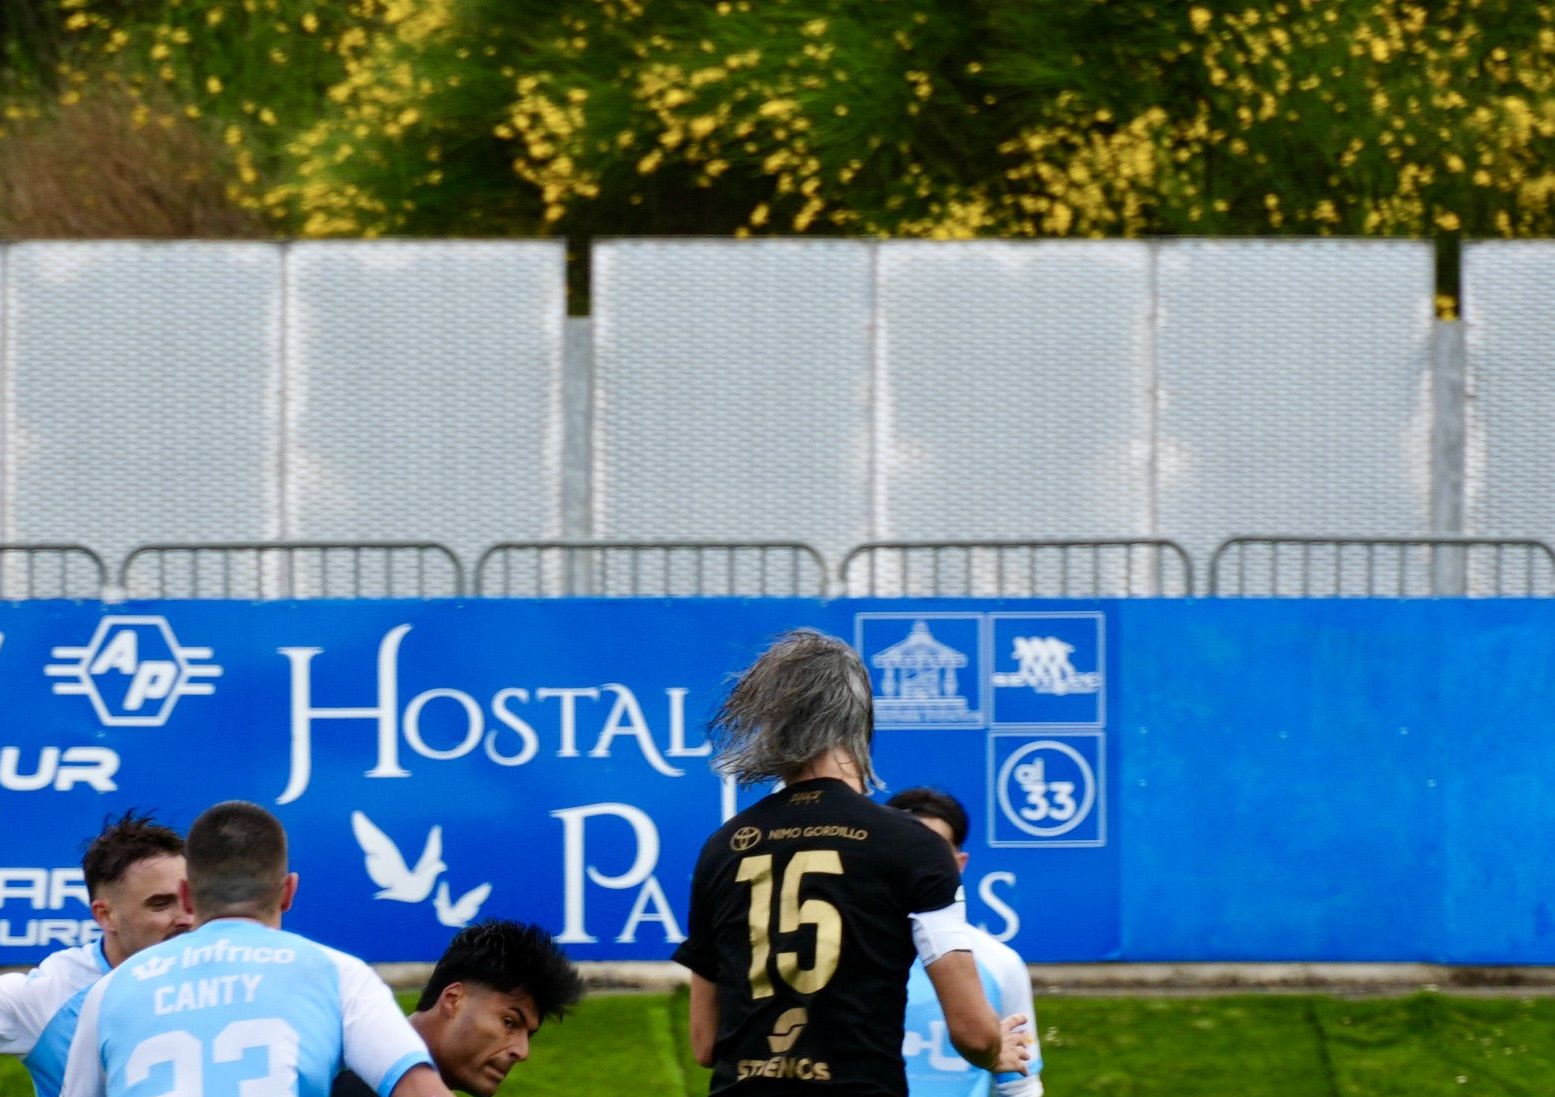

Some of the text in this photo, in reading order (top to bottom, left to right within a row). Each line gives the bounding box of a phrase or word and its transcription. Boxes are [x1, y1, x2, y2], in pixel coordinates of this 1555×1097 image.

[90, 629, 177, 711] AP
[275, 623, 712, 805] HOSTAL
[1020, 781, 1077, 821] 33
[181, 939, 295, 969] Infrico
[735, 849, 844, 1000] 15
[154, 973, 264, 1016] CANTY
